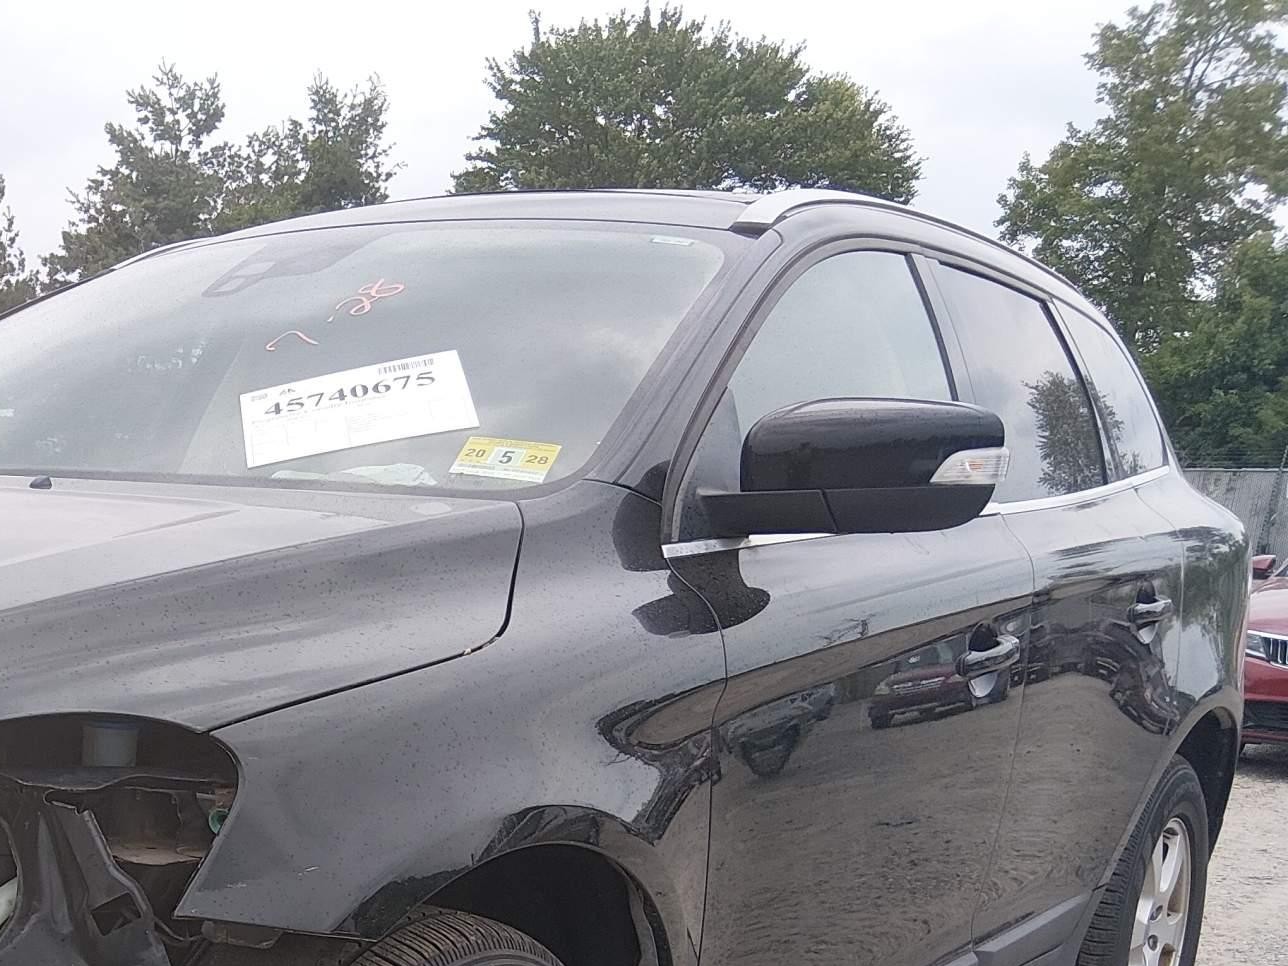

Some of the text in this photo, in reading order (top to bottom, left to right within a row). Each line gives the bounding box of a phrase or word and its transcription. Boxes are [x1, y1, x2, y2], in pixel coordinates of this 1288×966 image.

[264, 371, 436, 416] 45740675
[464, 448, 549, 465] 20 5 28
